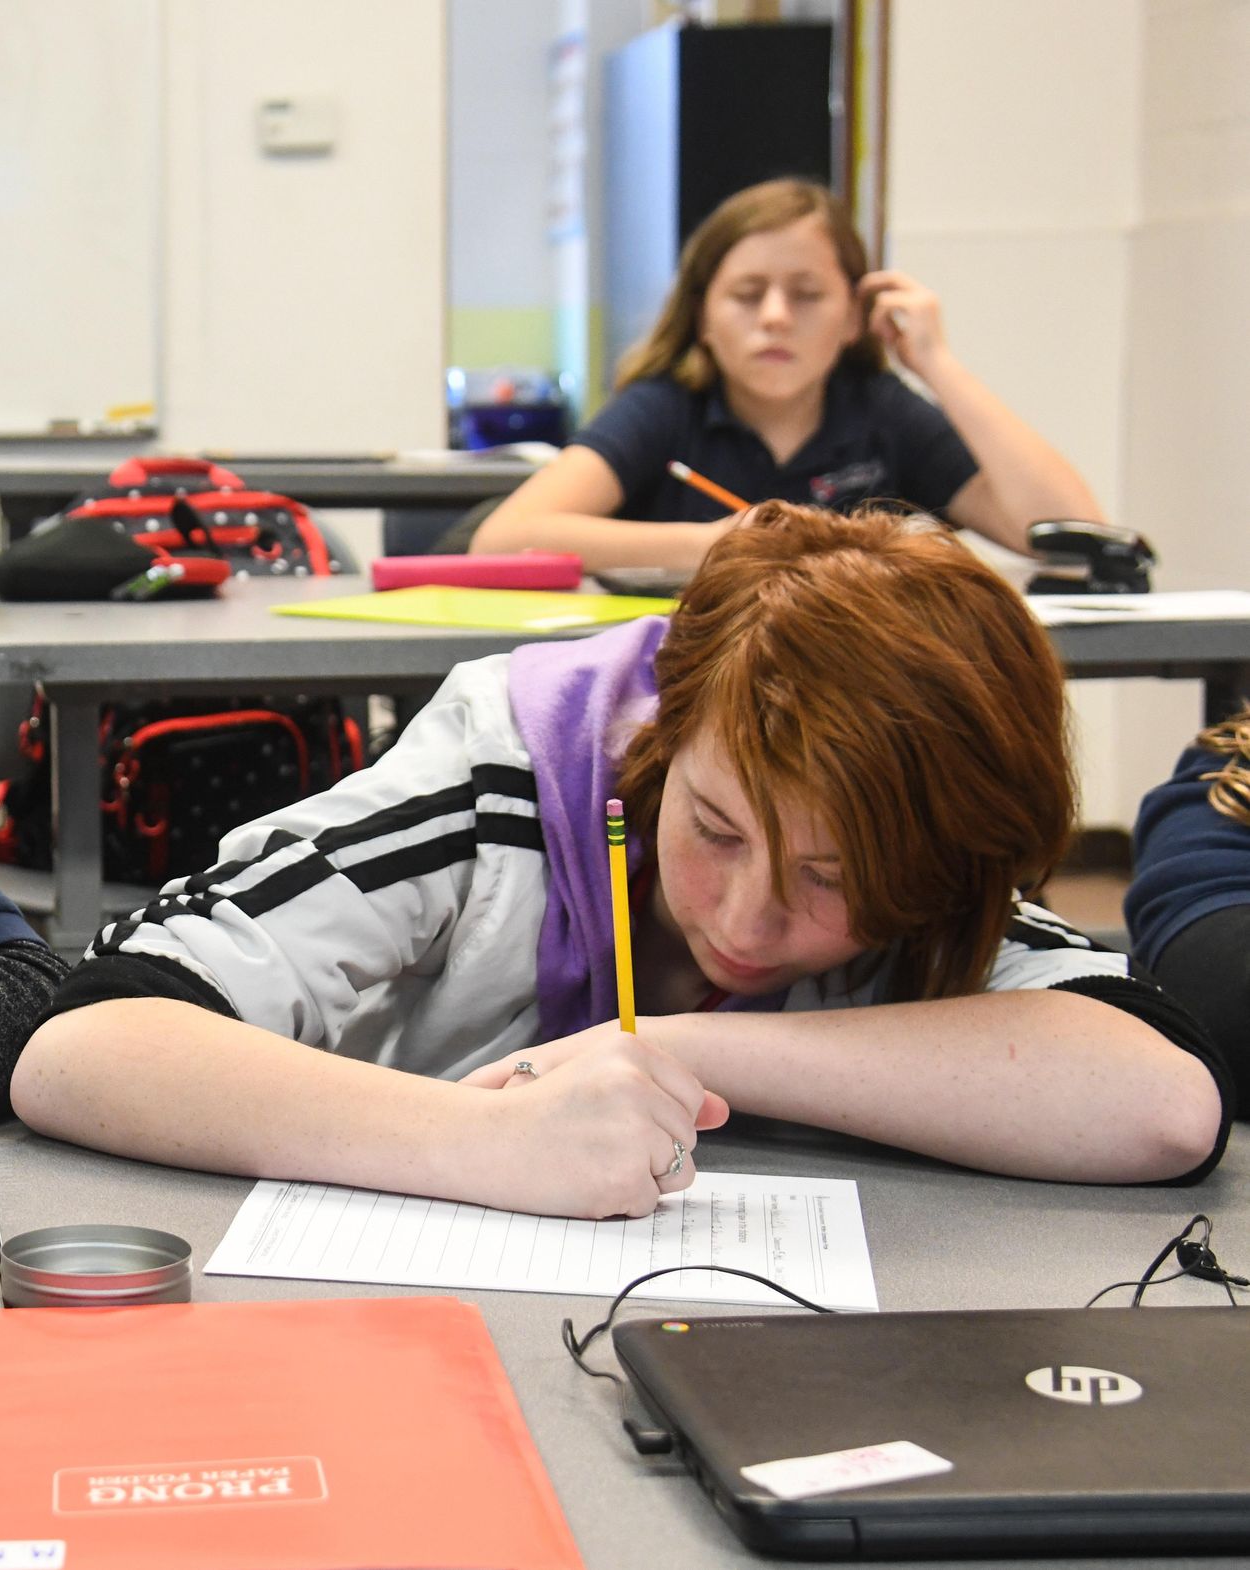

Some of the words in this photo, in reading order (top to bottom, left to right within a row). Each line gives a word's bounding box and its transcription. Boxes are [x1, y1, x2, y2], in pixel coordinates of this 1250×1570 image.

[1050, 1364, 1121, 1406] hp
[88, 1472, 191, 1487] FOLDER
[201, 1466, 291, 1482] PAPER
[87, 1477, 294, 1504] PRONG
